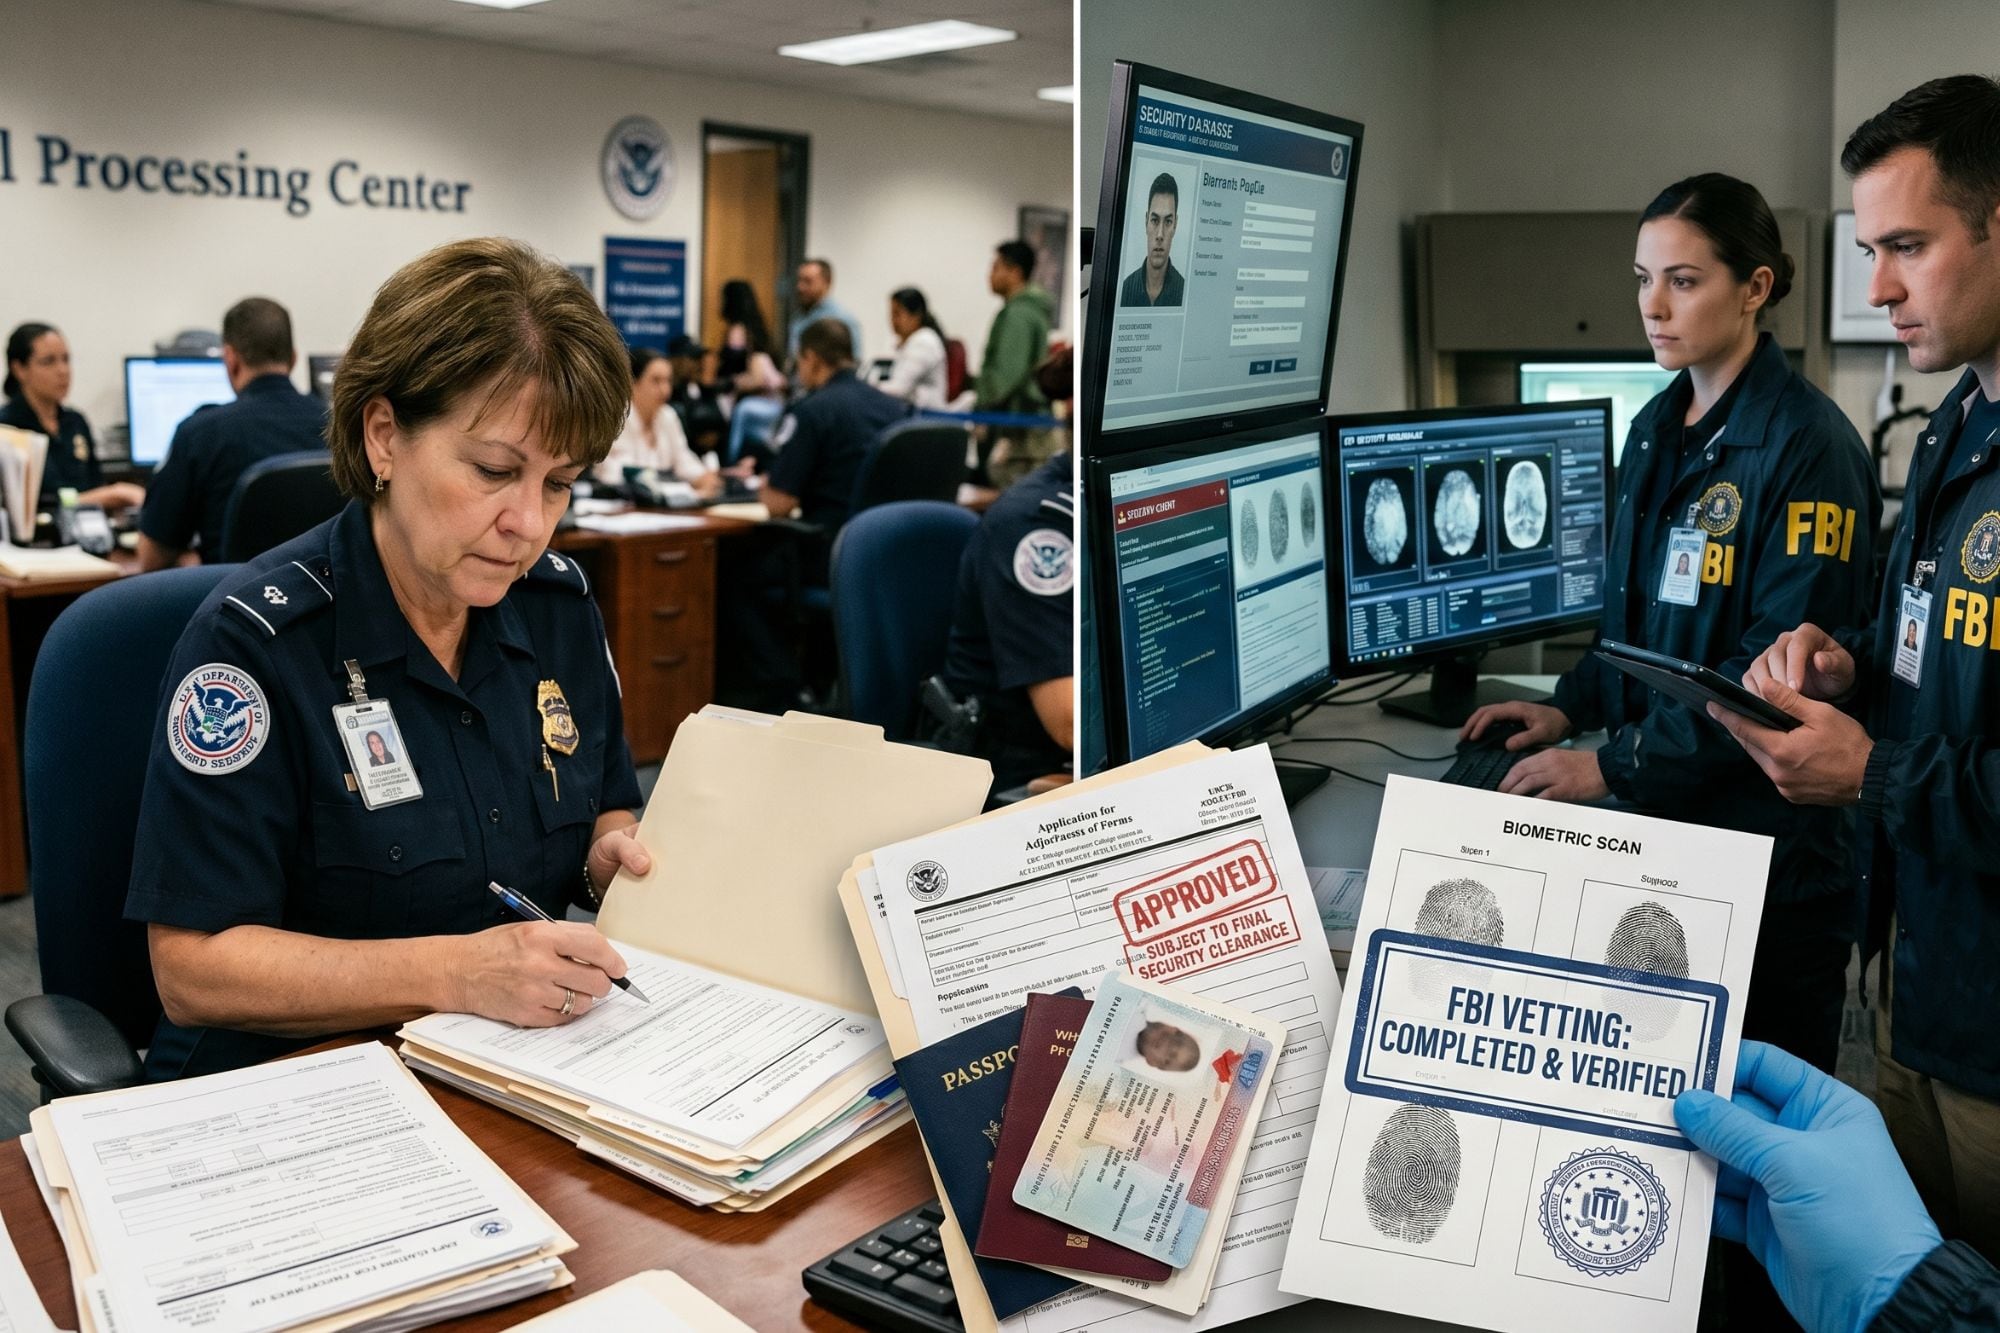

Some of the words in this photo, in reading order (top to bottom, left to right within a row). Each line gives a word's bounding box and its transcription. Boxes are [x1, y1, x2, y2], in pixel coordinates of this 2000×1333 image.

[1139, 104, 1191, 129] SECURITY
[36, 134, 311, 216] Processing
[328, 161, 471, 213] Center
[1786, 502, 1856, 563] FBI
[1701, 541, 1735, 586] BI
[1943, 586, 2000, 651] FBI
[1038, 810, 1098, 834] Application
[1100, 804, 1116, 816] for
[1087, 822, 1100, 834] of
[1503, 820, 1592, 847] BIOMETRIC
[1596, 836, 1642, 855] SCAN
[1132, 855, 1261, 933] APPROVED
[1139, 947, 1205, 980] SECURITY
[1208, 921, 1290, 959] CLEARANCE
[1146, 929, 1206, 960] SUBJECT
[1210, 922, 1229, 940] TO
[1232, 909, 1273, 933] FINAL
[1055, 1028, 1080, 1042] WH
[1446, 986, 1495, 1027] FBI
[1503, 994, 1633, 1051] VETTING:
[1379, 1019, 1536, 1076] COMPLETED
[1541, 1047, 1564, 1081] &
[1572, 1051, 1687, 1101] VERIFIED
